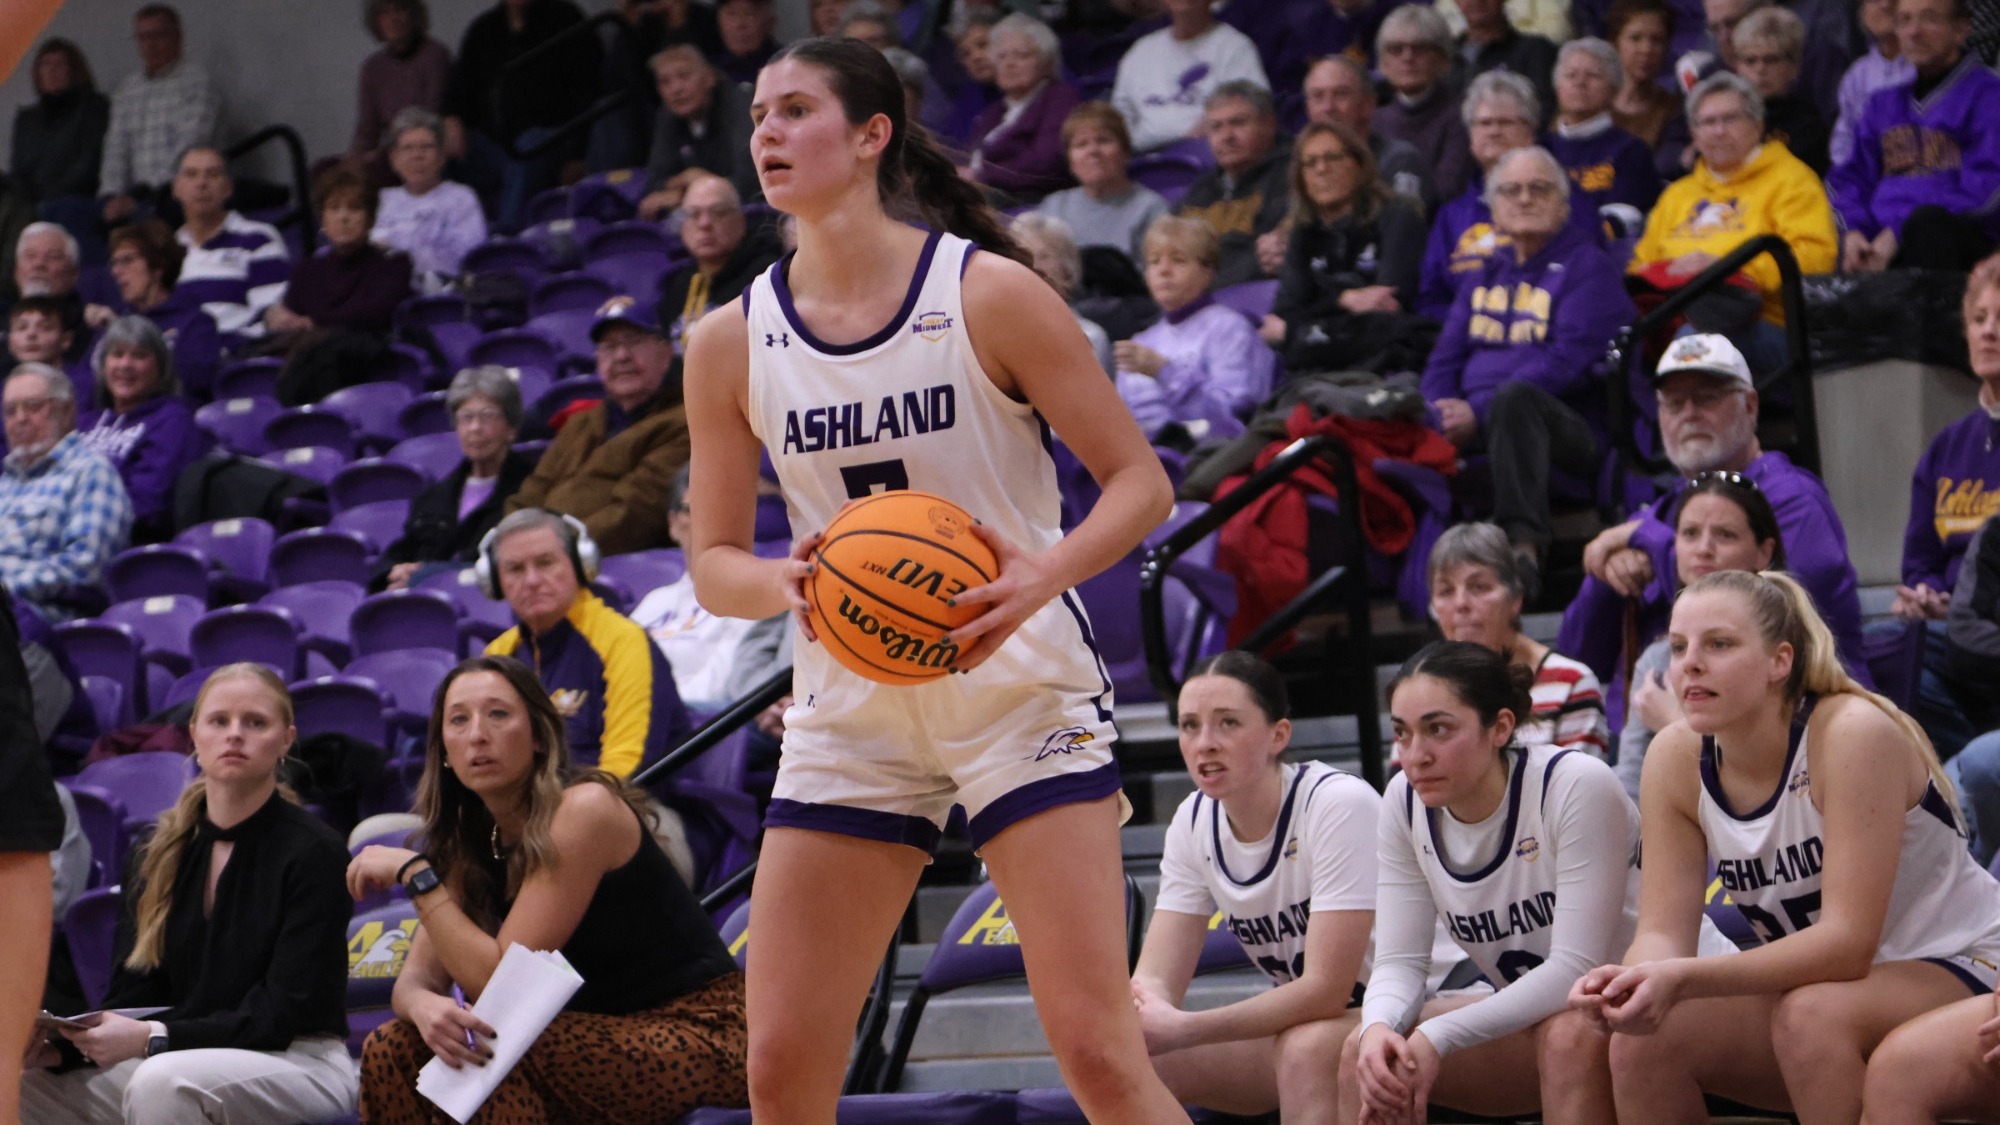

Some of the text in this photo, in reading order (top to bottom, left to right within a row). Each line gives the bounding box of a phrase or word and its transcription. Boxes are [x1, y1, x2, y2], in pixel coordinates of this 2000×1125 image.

[783, 384, 956, 455] ASHLAND
[859, 560, 888, 577] NXT
[838, 593, 959, 668] Wilson
